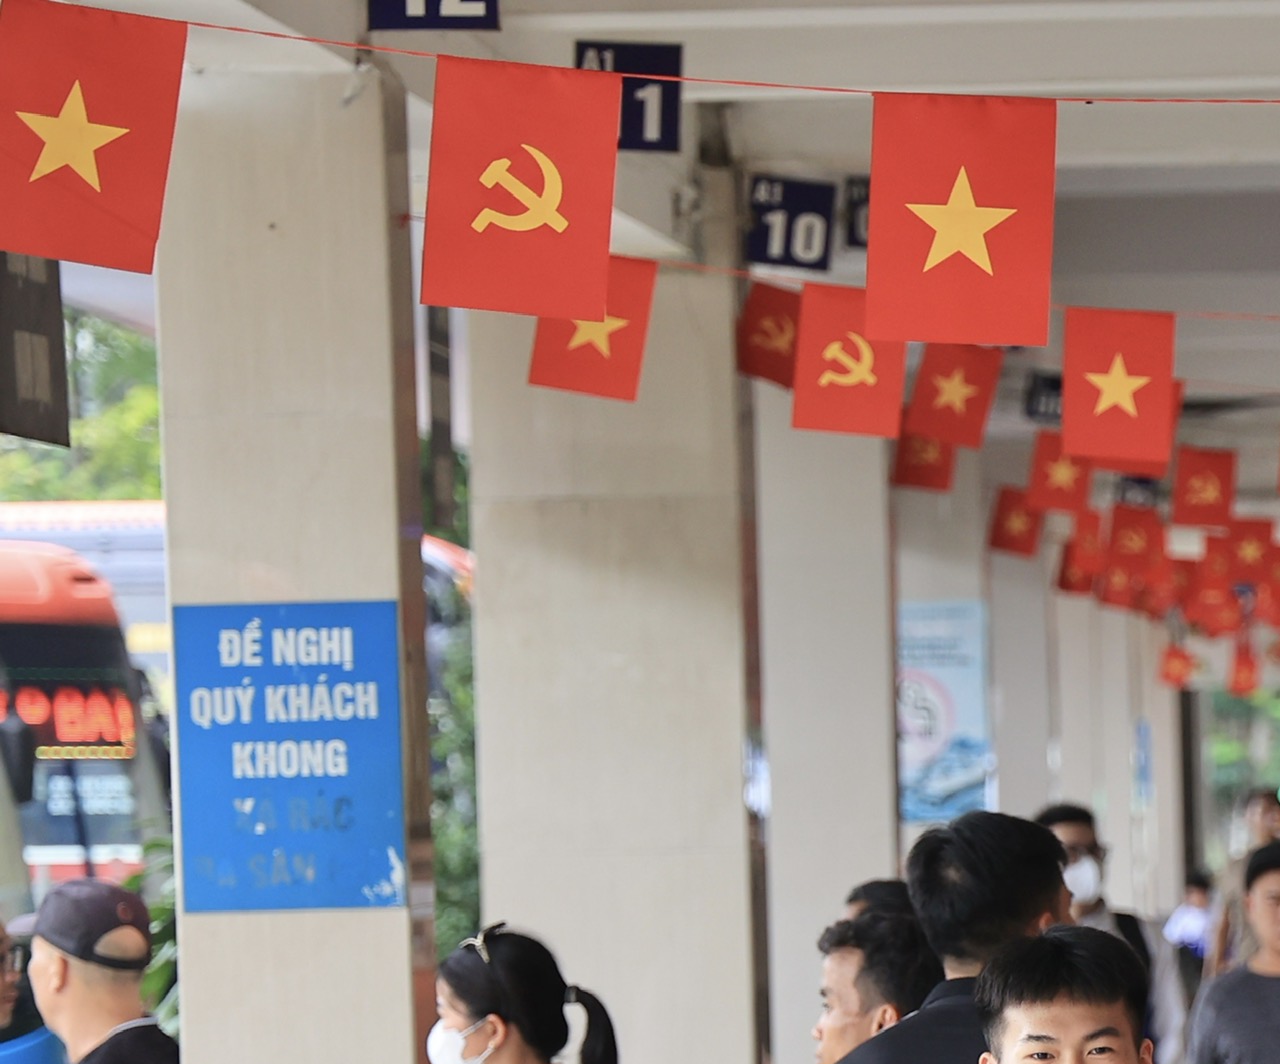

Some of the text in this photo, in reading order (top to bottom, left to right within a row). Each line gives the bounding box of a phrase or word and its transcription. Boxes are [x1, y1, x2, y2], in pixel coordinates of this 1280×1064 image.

[633, 83, 663, 142] 1
[761, 208, 829, 264] 10
[271, 626, 354, 671] NGHỊ
[190, 673, 378, 730] QUÝ KHÁCH
